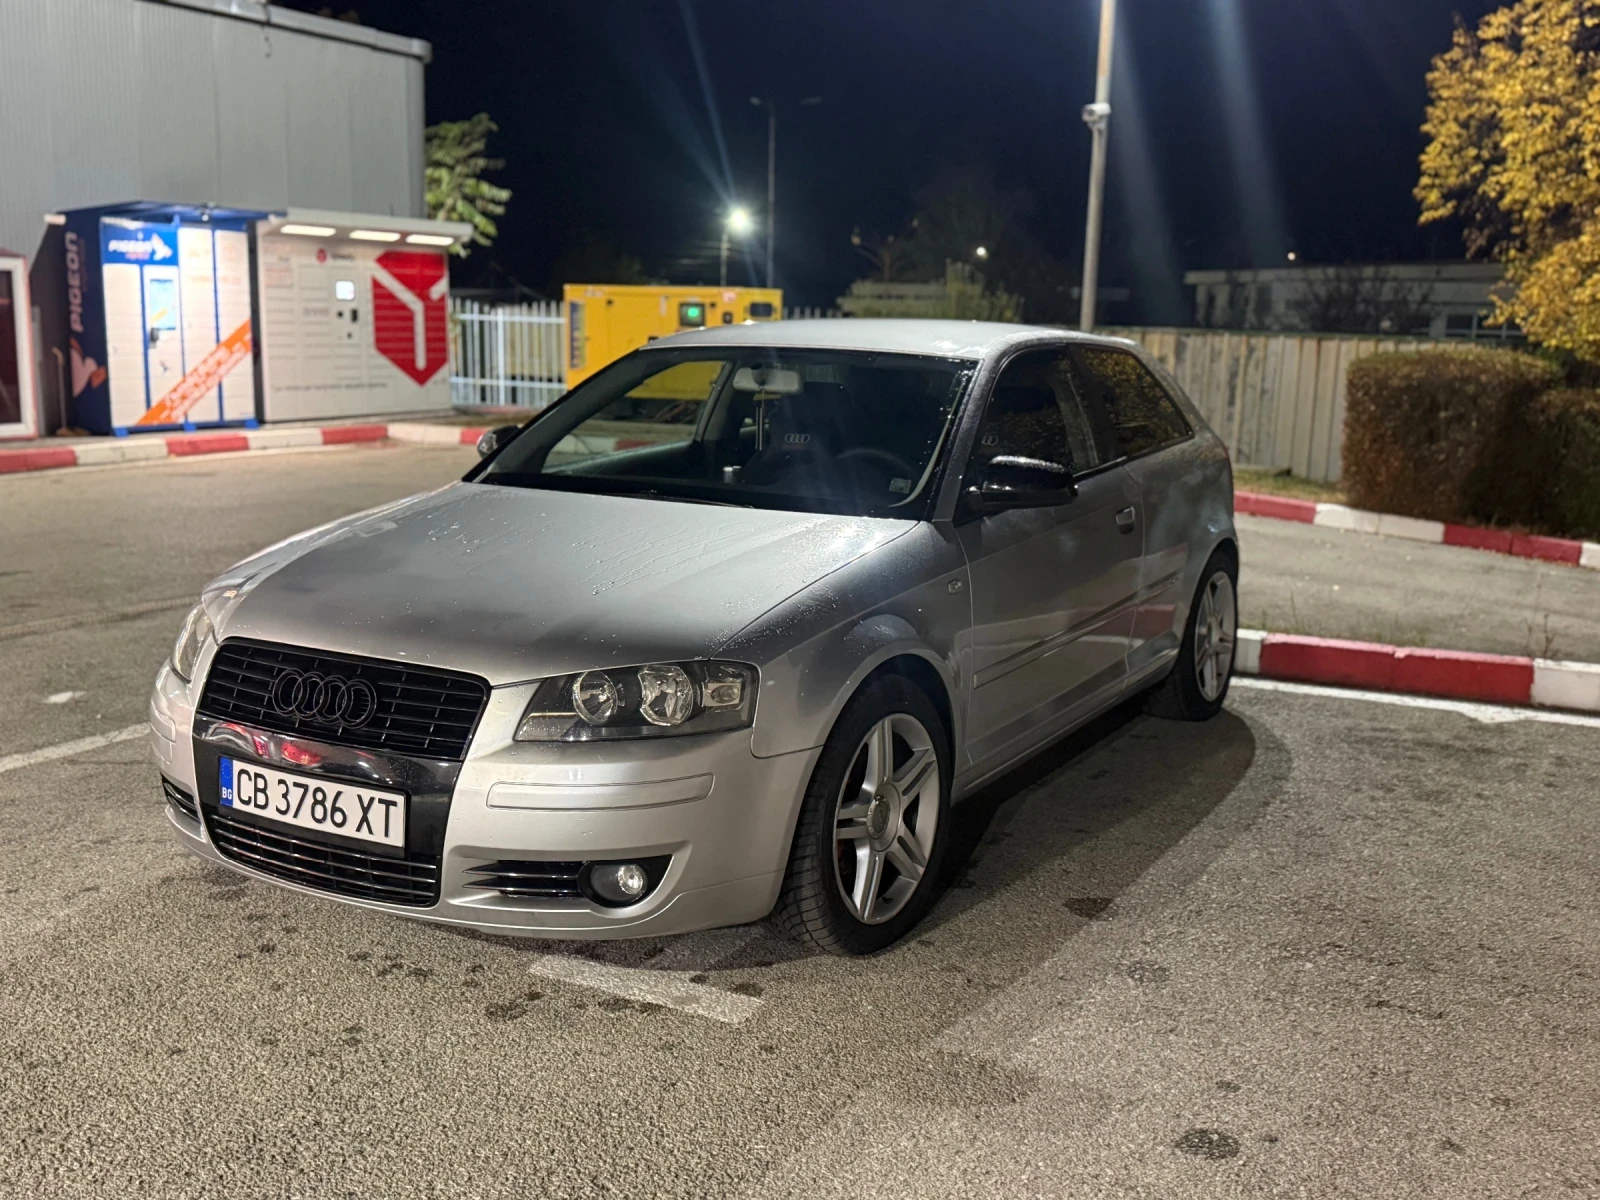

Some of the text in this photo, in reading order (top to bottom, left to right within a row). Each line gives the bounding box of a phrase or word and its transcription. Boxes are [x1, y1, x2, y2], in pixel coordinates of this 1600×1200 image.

[222, 788, 233, 800] BG
[237, 768, 398, 837] CB 3786 XT
